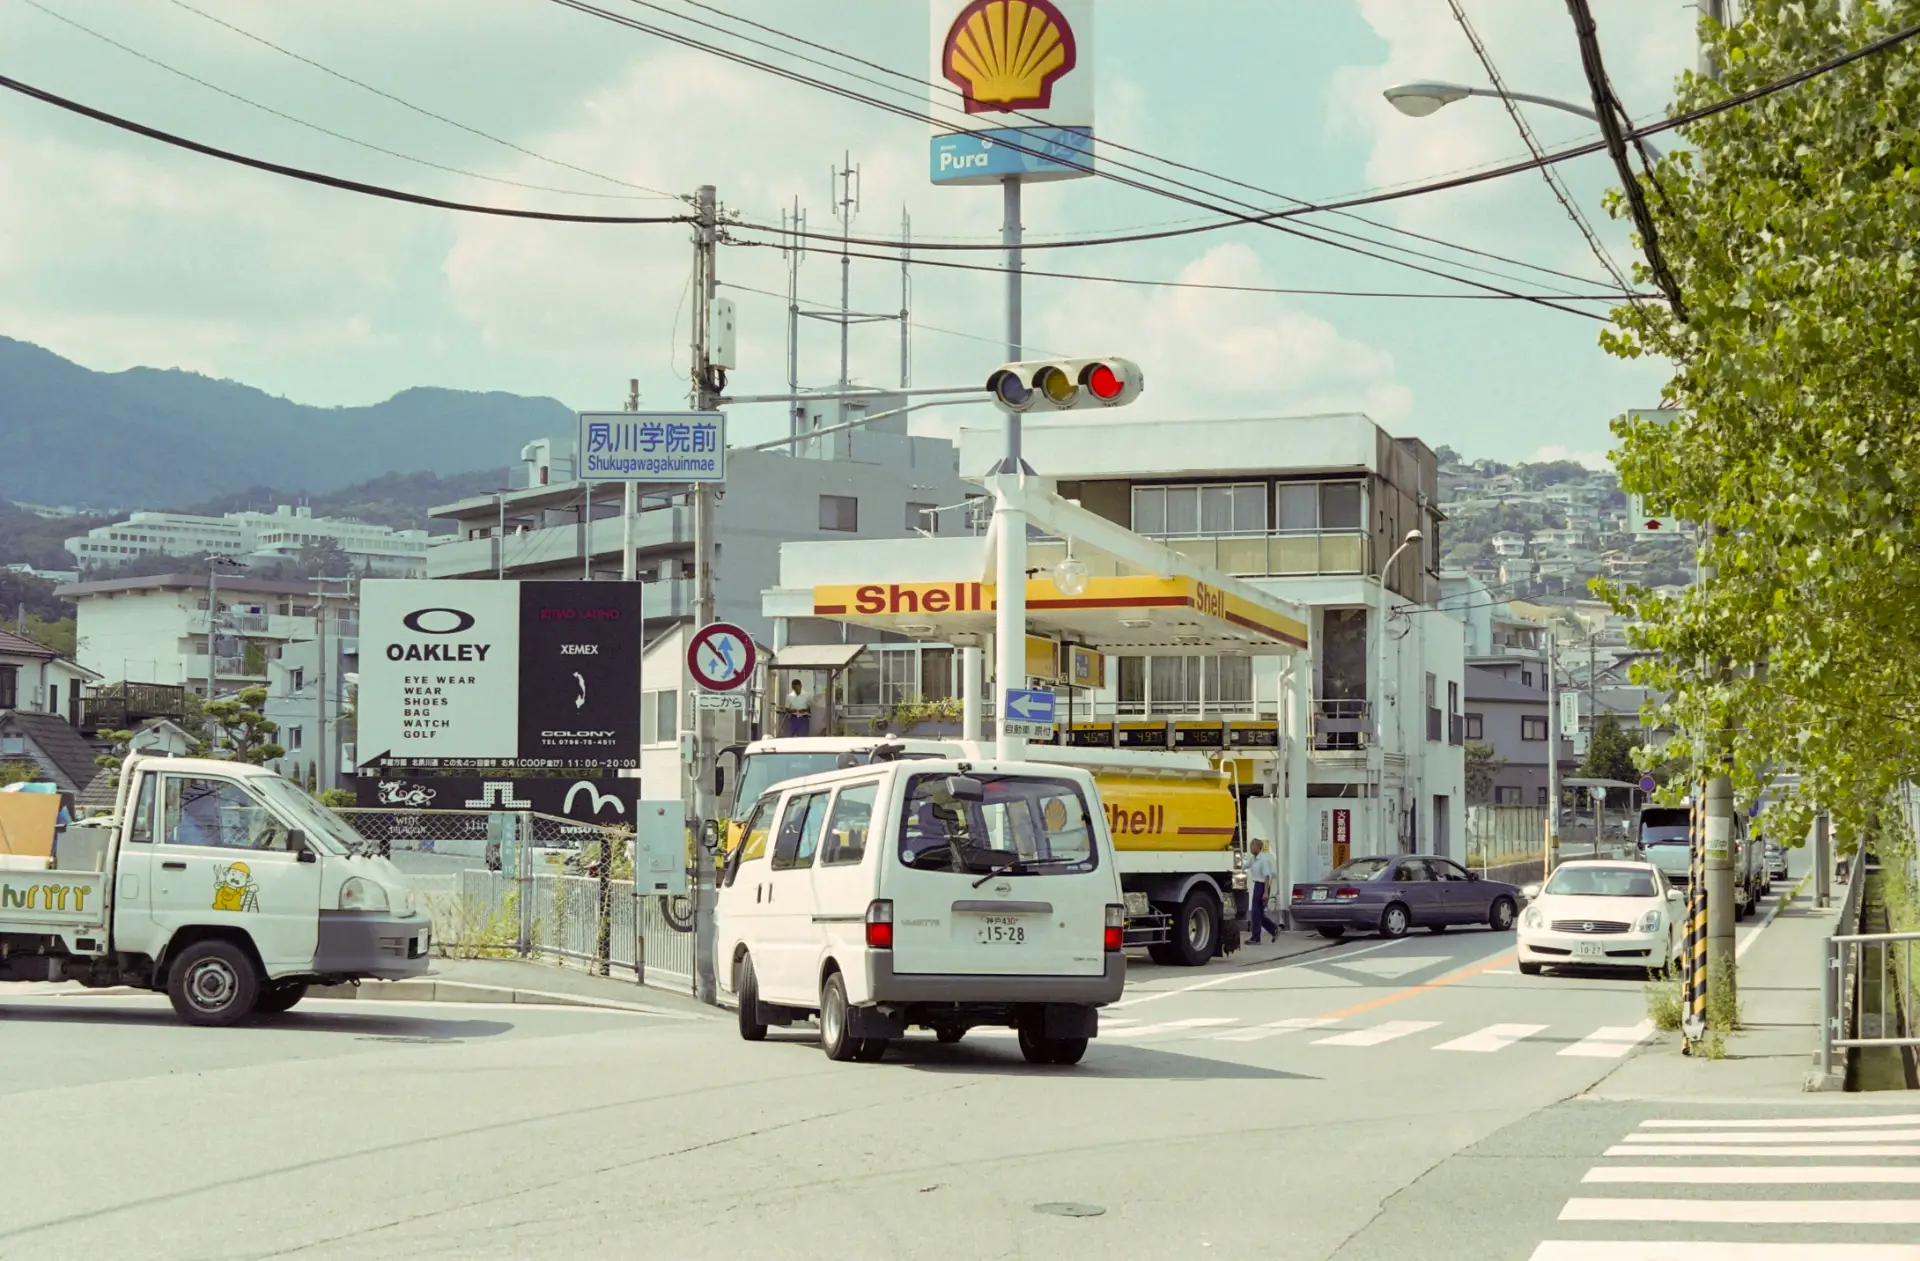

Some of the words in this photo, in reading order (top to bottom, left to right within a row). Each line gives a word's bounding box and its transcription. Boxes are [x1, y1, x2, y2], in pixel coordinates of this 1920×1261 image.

[940, 152, 988, 171] Pura
[587, 422, 717, 453] 夙川学院前
[588, 454, 715, 473] Shukugawagakuinmae
[855, 582, 980, 615] Shell
[1196, 581, 1225, 618] Shell
[386, 643, 491, 662] OAKLEY
[560, 644, 599, 655] XEMEX
[404, 676, 429, 684] EYE
[436, 676, 476, 684] WEAR
[404, 687, 442, 695] WEAR
[404, 698, 449, 706] SHOES
[700, 696, 742, 708] ここから
[404, 709, 430, 717] BAG
[404, 719, 450, 728] WATCH
[403, 730, 437, 739] GOLF
[1005, 724, 1030, 735] 自動車
[987, 926, 1025, 941] 15-28
